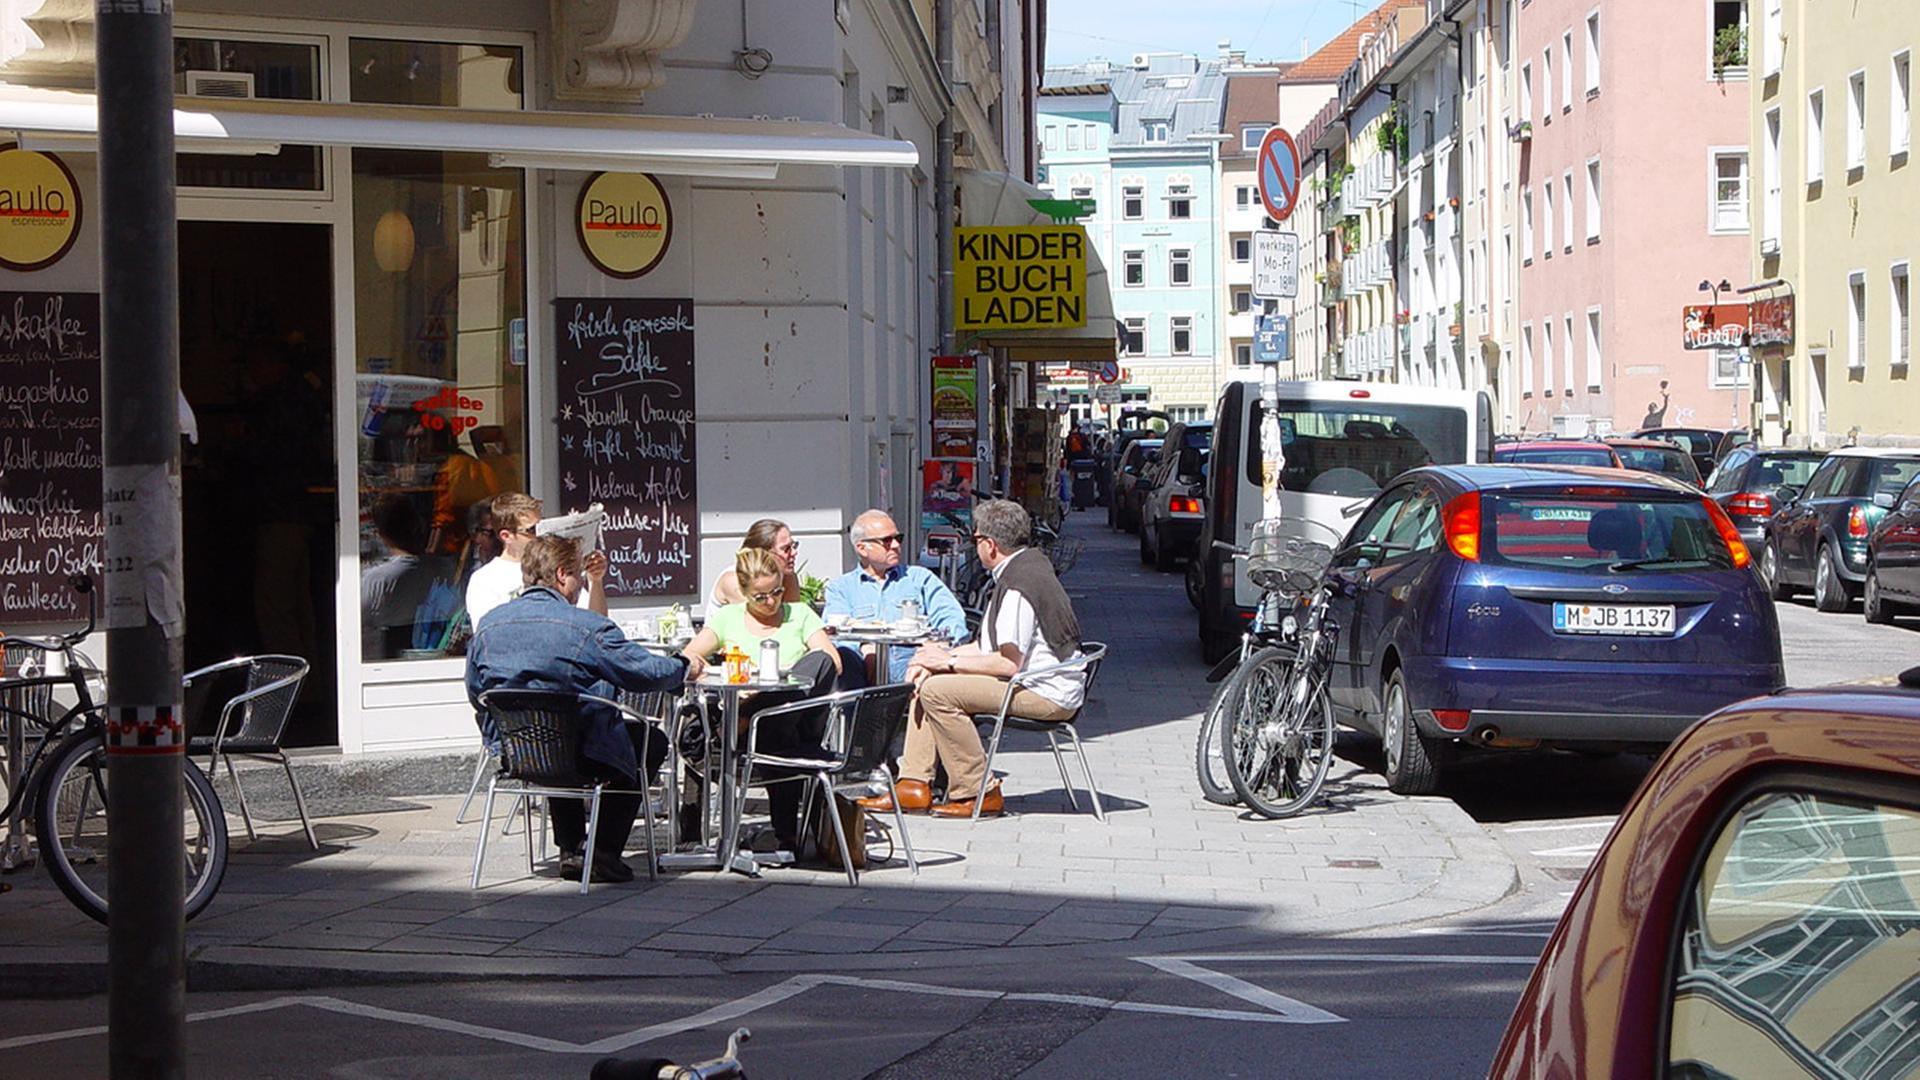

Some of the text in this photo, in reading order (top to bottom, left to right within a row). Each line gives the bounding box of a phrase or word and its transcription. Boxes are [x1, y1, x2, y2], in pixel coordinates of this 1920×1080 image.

[589, 199, 659, 228] Paulo
[959, 232, 1082, 262] KINDER
[1258, 239, 1295, 256] werktags
[1263, 255, 1292, 271] Mo-Fr
[976, 265, 1073, 294] BUCH
[963, 296, 1081, 325] LADEN
[412, 384, 484, 412] coffee
[421, 413, 478, 437] to go
[1567, 607, 1671, 628] M JB 1137
